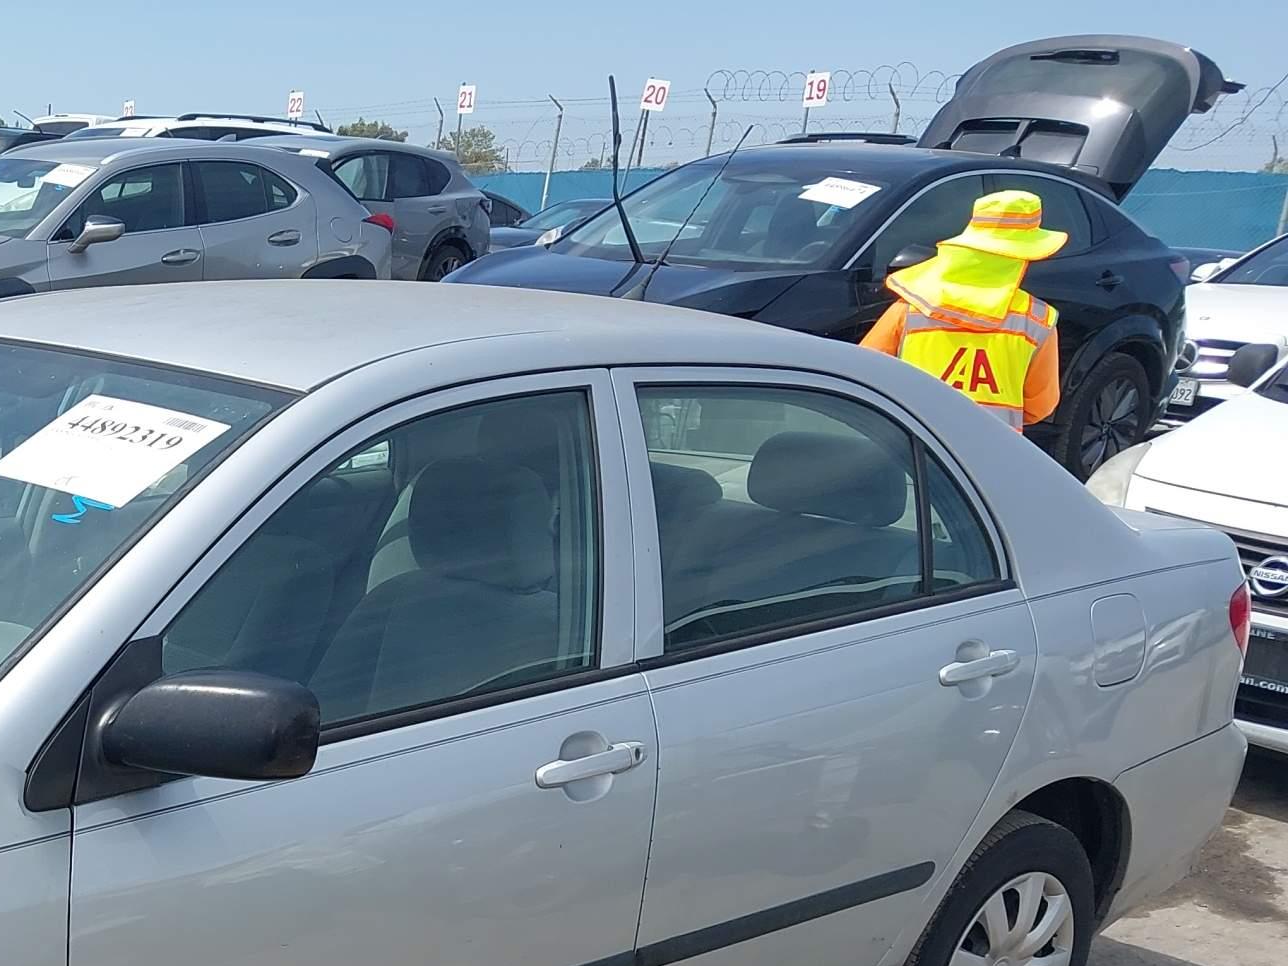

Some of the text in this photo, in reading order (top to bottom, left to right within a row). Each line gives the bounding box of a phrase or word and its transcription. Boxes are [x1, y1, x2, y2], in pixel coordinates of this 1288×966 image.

[459, 91, 473, 108] 21
[643, 84, 667, 105] 20
[805, 79, 827, 100] 19
[289, 98, 302, 113] 22
[68, 415, 183, 450] 44892319
